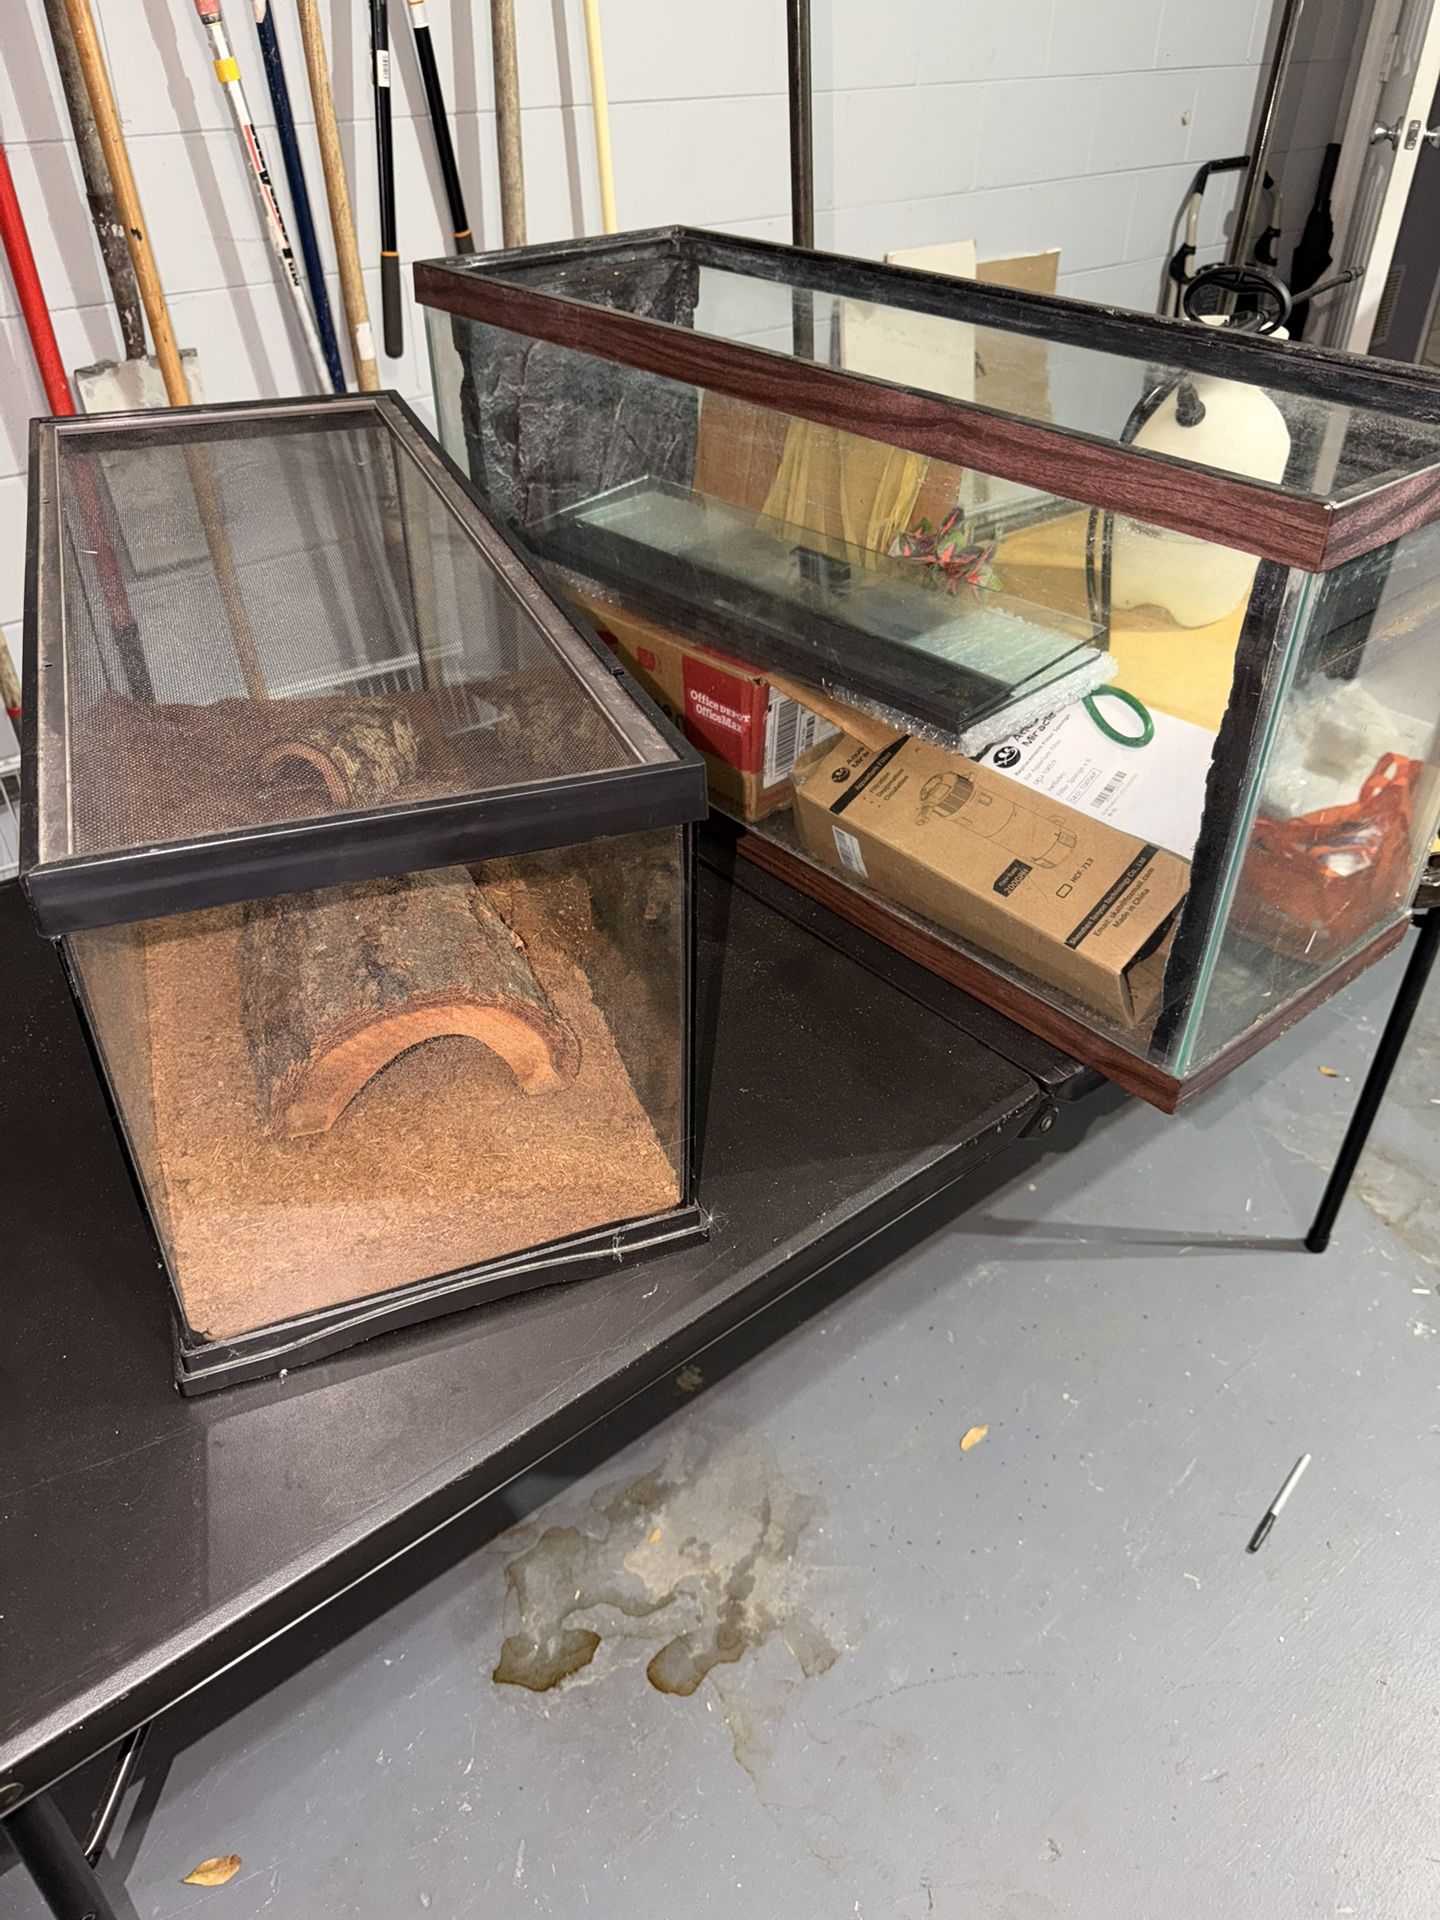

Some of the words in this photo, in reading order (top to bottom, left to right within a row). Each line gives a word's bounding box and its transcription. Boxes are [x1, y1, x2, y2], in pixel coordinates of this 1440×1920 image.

[690, 689, 719, 709] Office
[720, 706, 750, 722] DEPOT
[697, 703, 741, 732] OfficeMax
[1021, 712, 1056, 745] Miracle
[1113, 910, 1130, 928] Made
[1127, 903, 1135, 911] in
[1132, 887, 1149, 905] China
